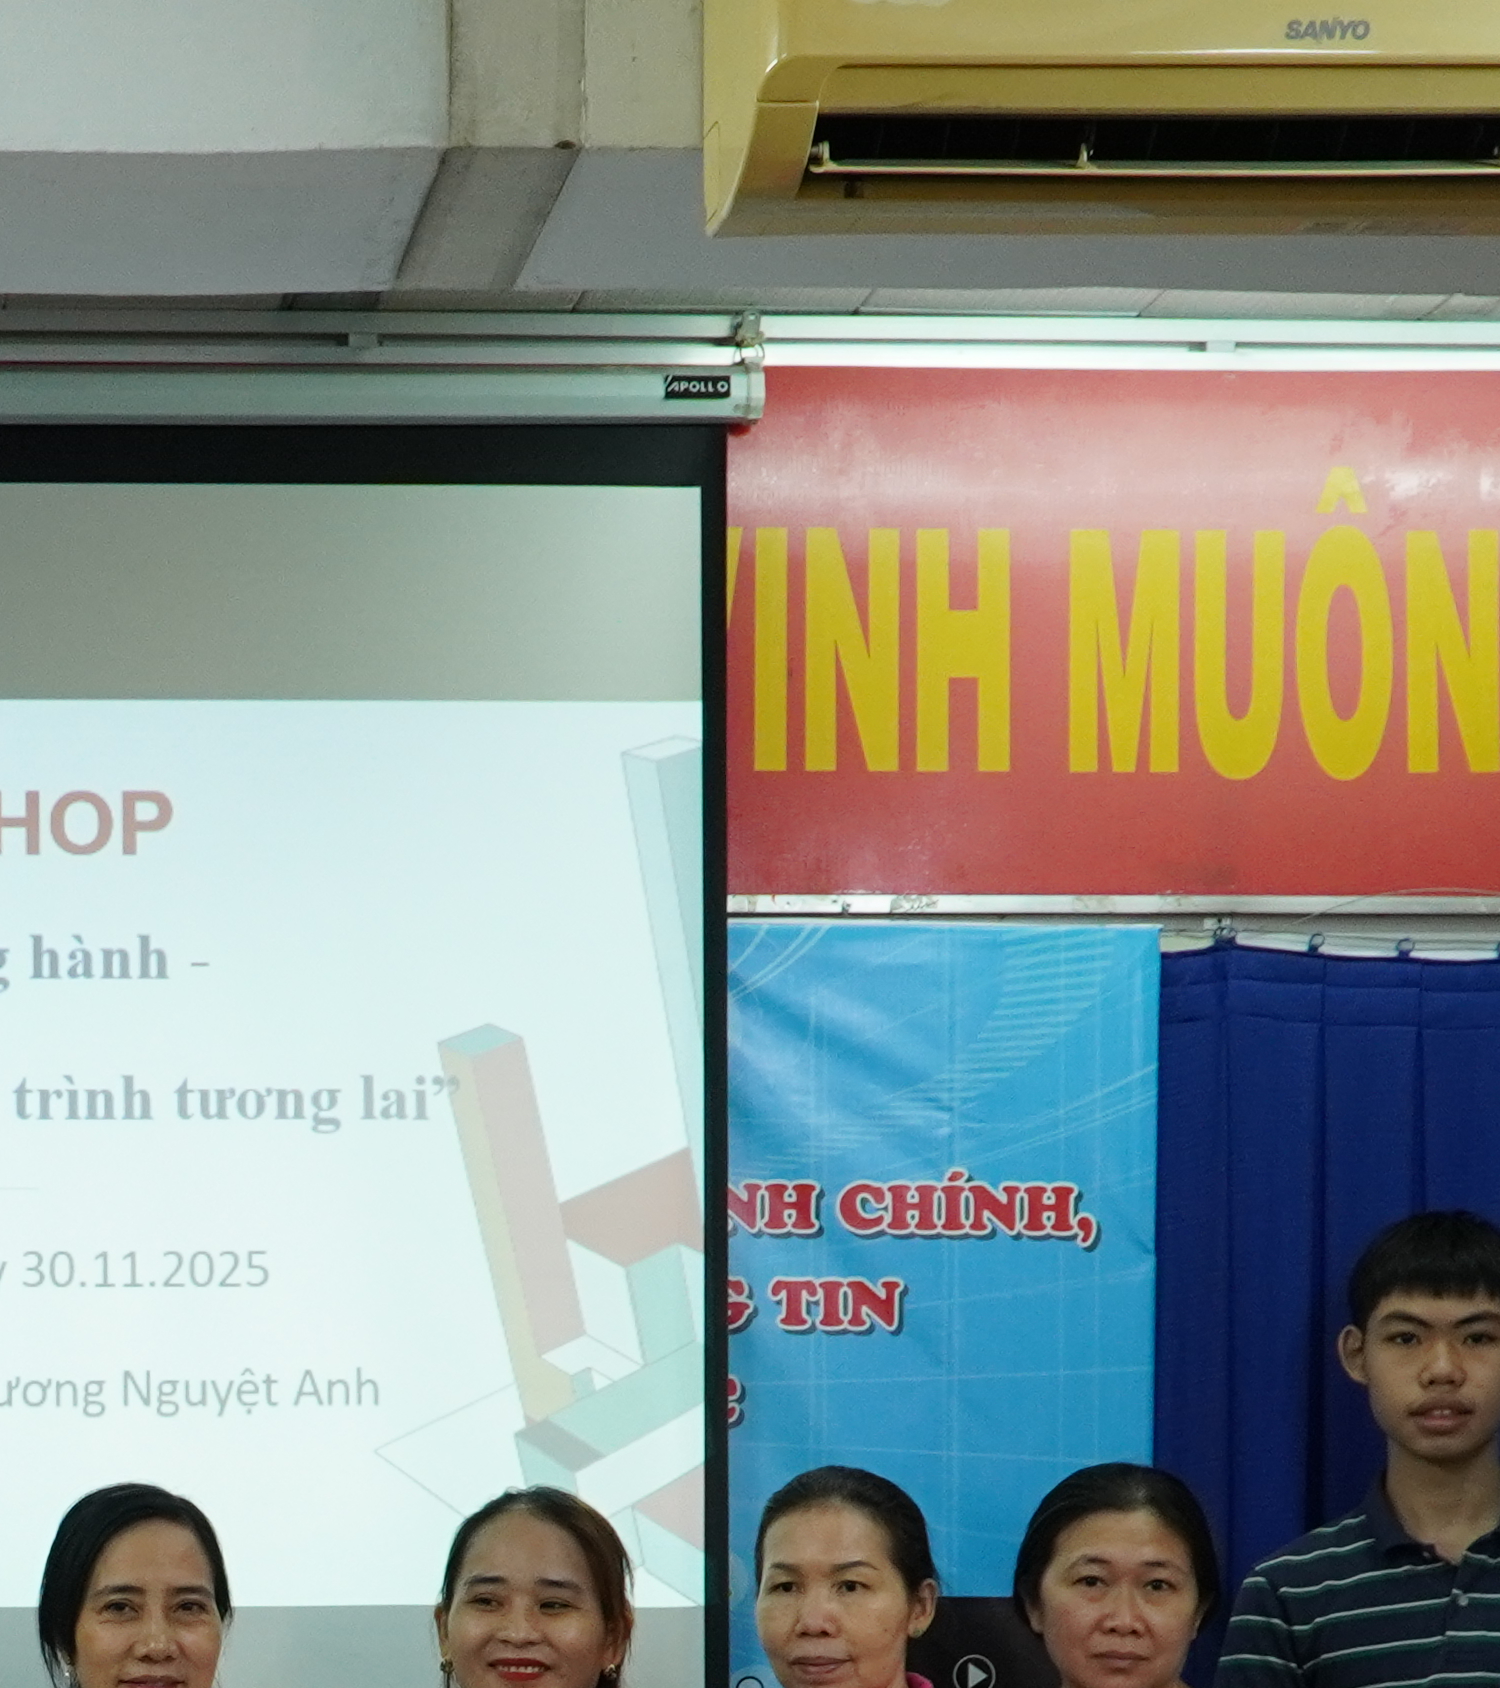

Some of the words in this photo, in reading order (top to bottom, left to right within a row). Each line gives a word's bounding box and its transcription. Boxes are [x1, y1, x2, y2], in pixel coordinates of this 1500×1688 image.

[1285, 18, 1370, 41] SANYO
[666, 379, 729, 393] APOLLO
[726, 526, 1012, 773] INH
[29, 933, 170, 981] hành
[13, 1073, 154, 1121] trình
[173, 1077, 342, 1135] tương
[360, 1074, 461, 1122] lai”
[837, 1167, 1099, 1248] CHÍNH,
[22, 1249, 270, 1289] 30.11.2025
[769, 1276, 905, 1331] TIN
[122, 1366, 279, 1418] Nguyệt
[292, 1366, 380, 1407] Anh
